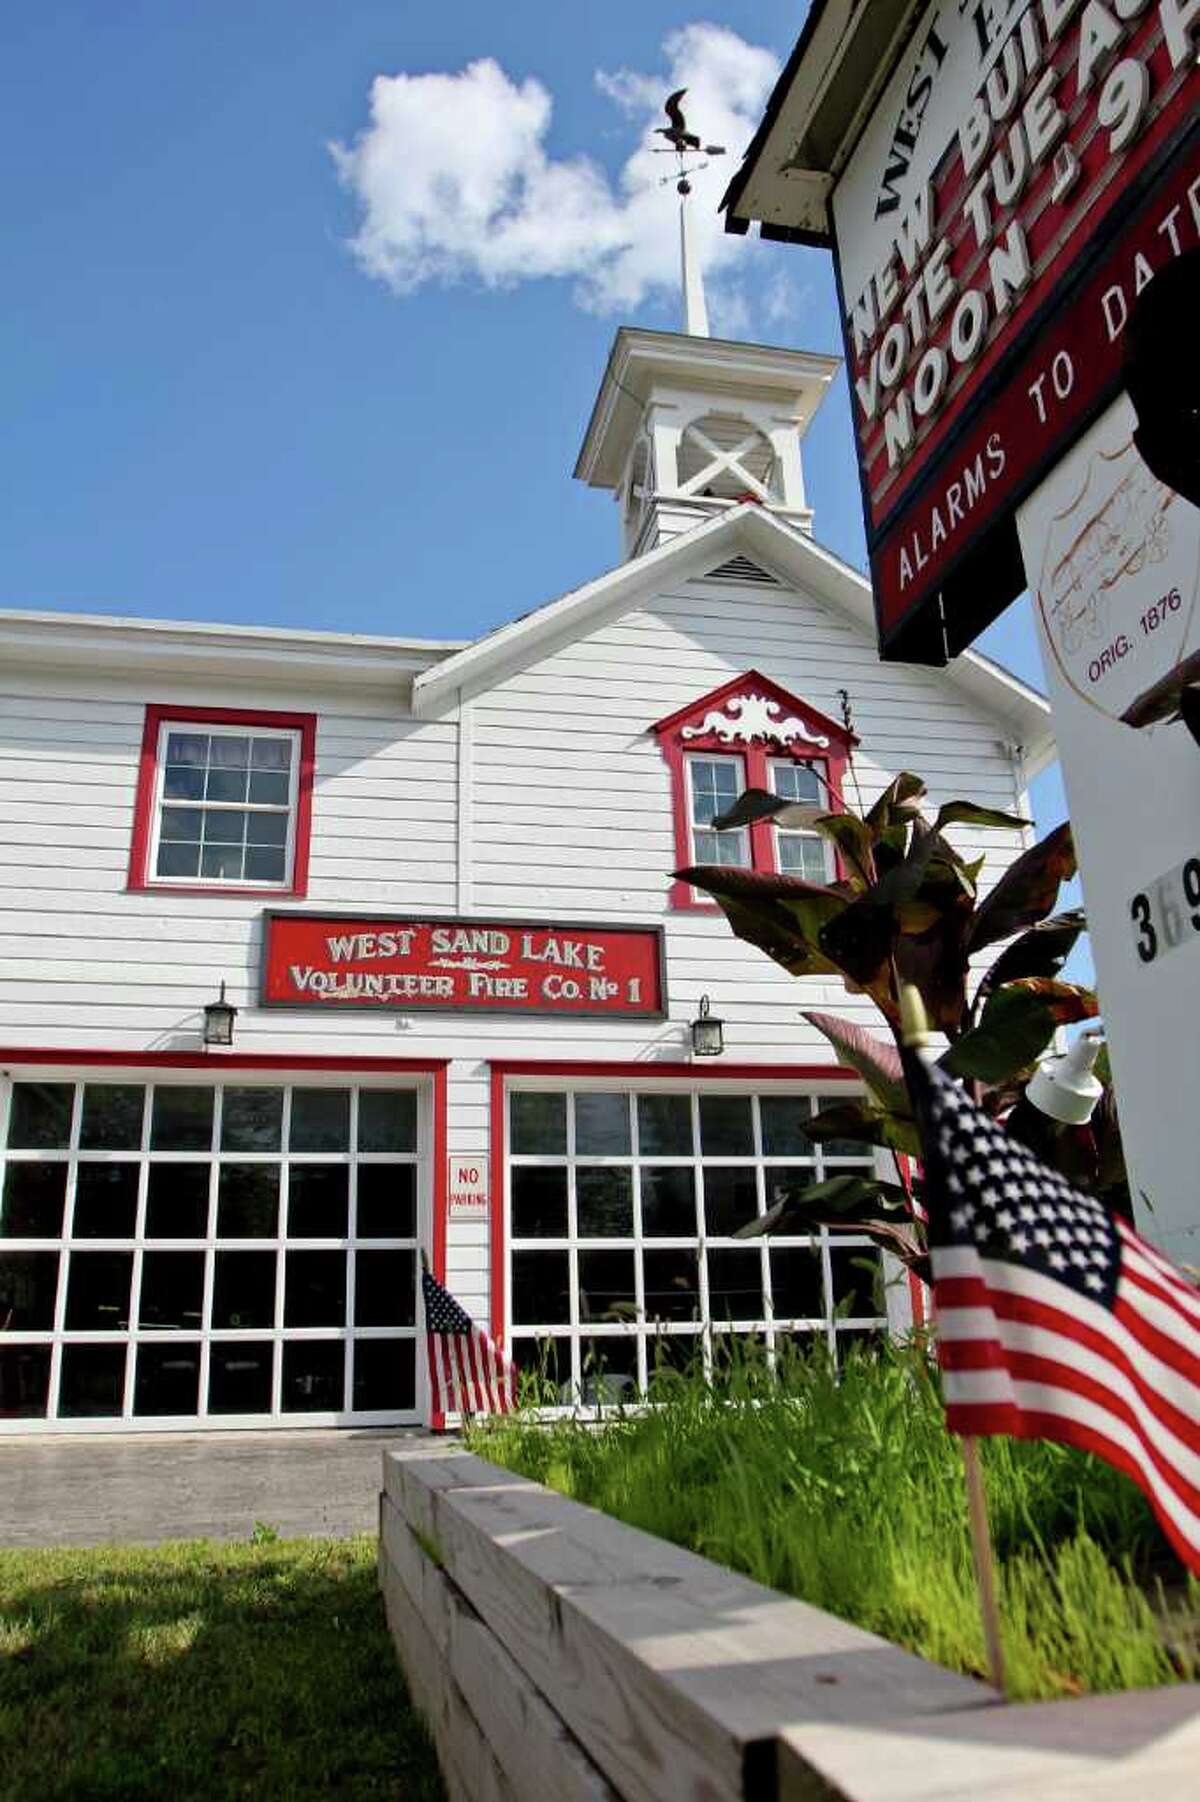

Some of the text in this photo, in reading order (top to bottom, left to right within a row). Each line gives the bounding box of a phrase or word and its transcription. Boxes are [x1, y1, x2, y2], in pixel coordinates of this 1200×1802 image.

[874, 10, 949, 222] WEST
[852, 183, 932, 357] NEW
[855, 238, 954, 420] VOTE
[964, 66, 1062, 248] TUE
[885, 220, 1031, 469] NOON
[1098, 58, 1144, 153] 9
[899, 432, 1006, 592] ALARMS
[1028, 350, 1074, 423] TO
[1088, 588, 1182, 682] ORIG. 1876
[327, 929, 606, 972] WEST SAND LAKE
[628, 978, 642, 1003] 1
[458, 1168, 479, 1184] NO
